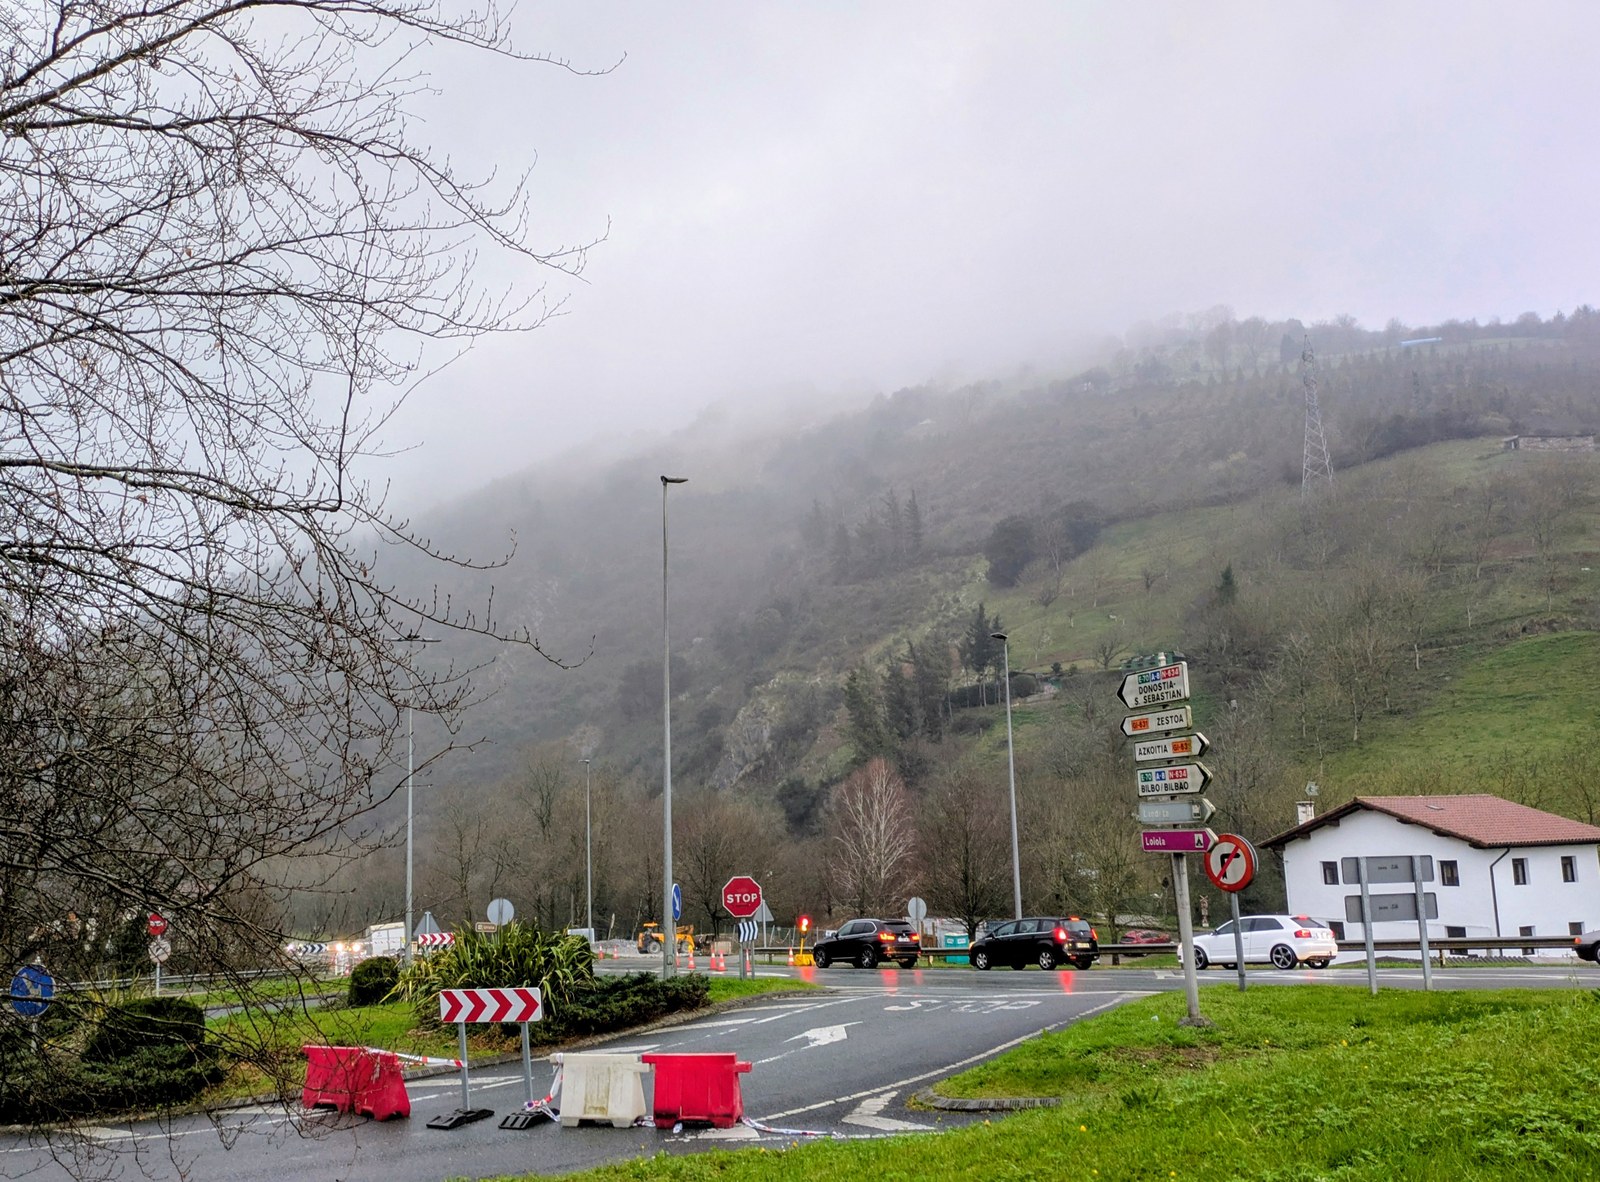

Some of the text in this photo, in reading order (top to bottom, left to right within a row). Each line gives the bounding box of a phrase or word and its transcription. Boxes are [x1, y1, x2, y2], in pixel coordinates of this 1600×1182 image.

[1151, 671, 1160, 681] A-8
[1143, 689, 1182, 703] SEBASTIAN
[1156, 714, 1184, 726] ZESTOA
[1138, 742, 1190, 756] AZKOITIA GI-63
[1156, 771, 1165, 780] A-8
[1168, 769, 1187, 779] N-634
[1145, 837, 1166, 846] Loiola
[726, 893, 758, 904] STOP
[883, 999, 1043, 1014] STOP
